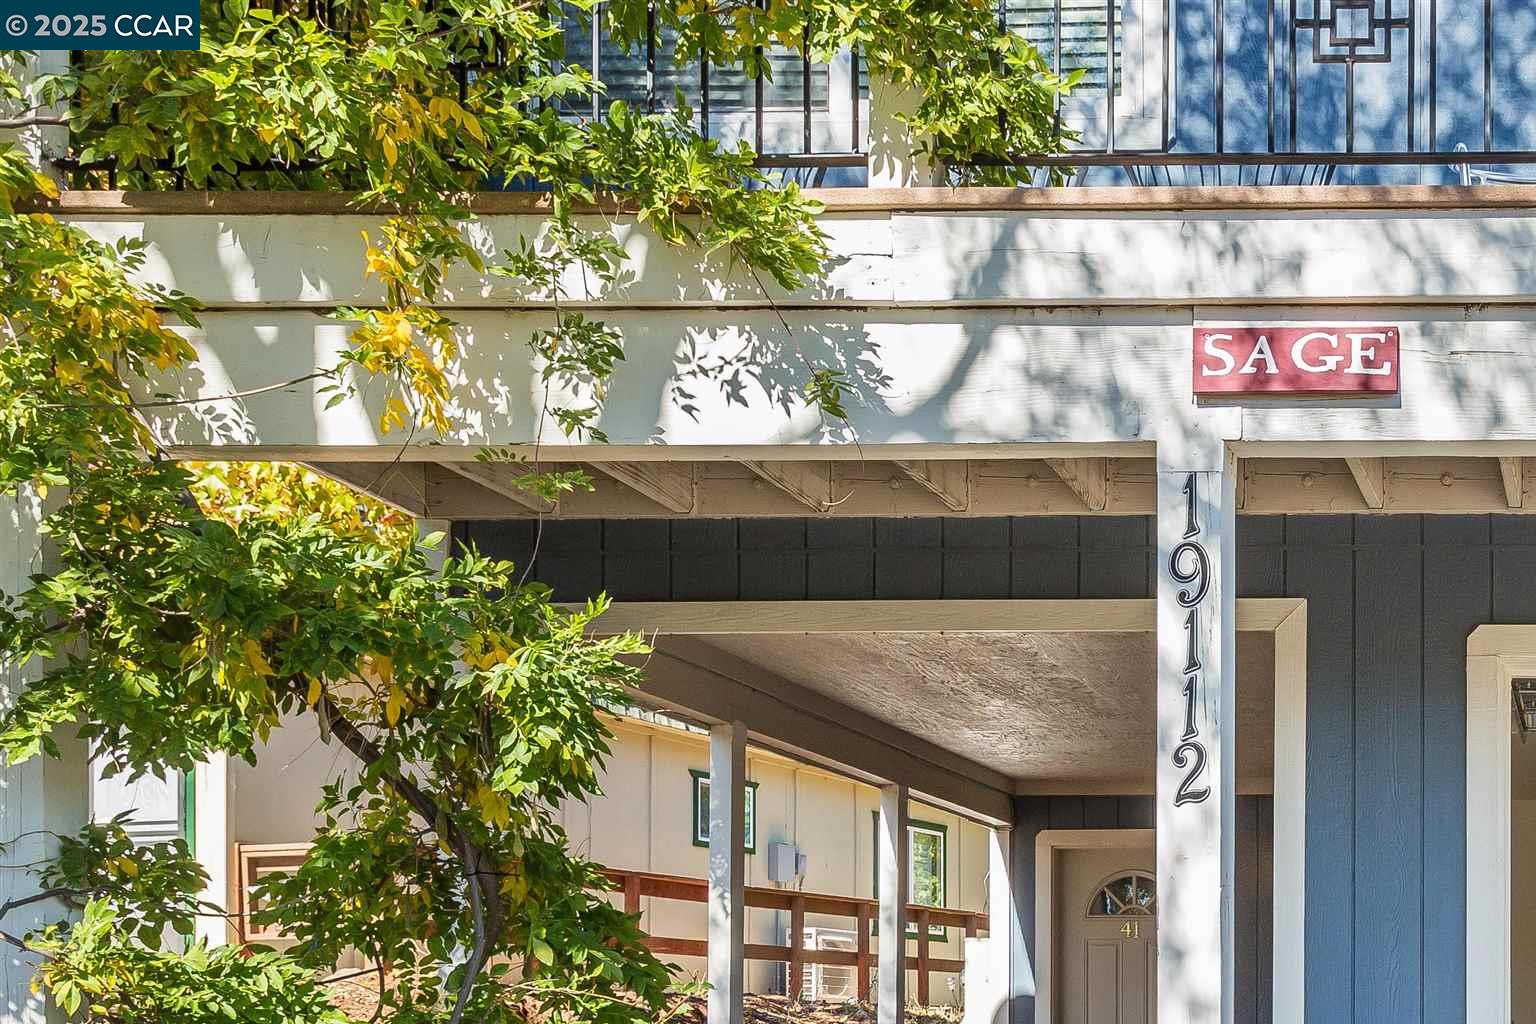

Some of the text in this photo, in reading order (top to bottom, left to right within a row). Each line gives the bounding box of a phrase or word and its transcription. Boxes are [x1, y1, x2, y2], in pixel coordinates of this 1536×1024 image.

[1201, 331, 1392, 377] SAGE
[1168, 471, 1211, 808] 19112
[1120, 919, 1139, 939] 41
